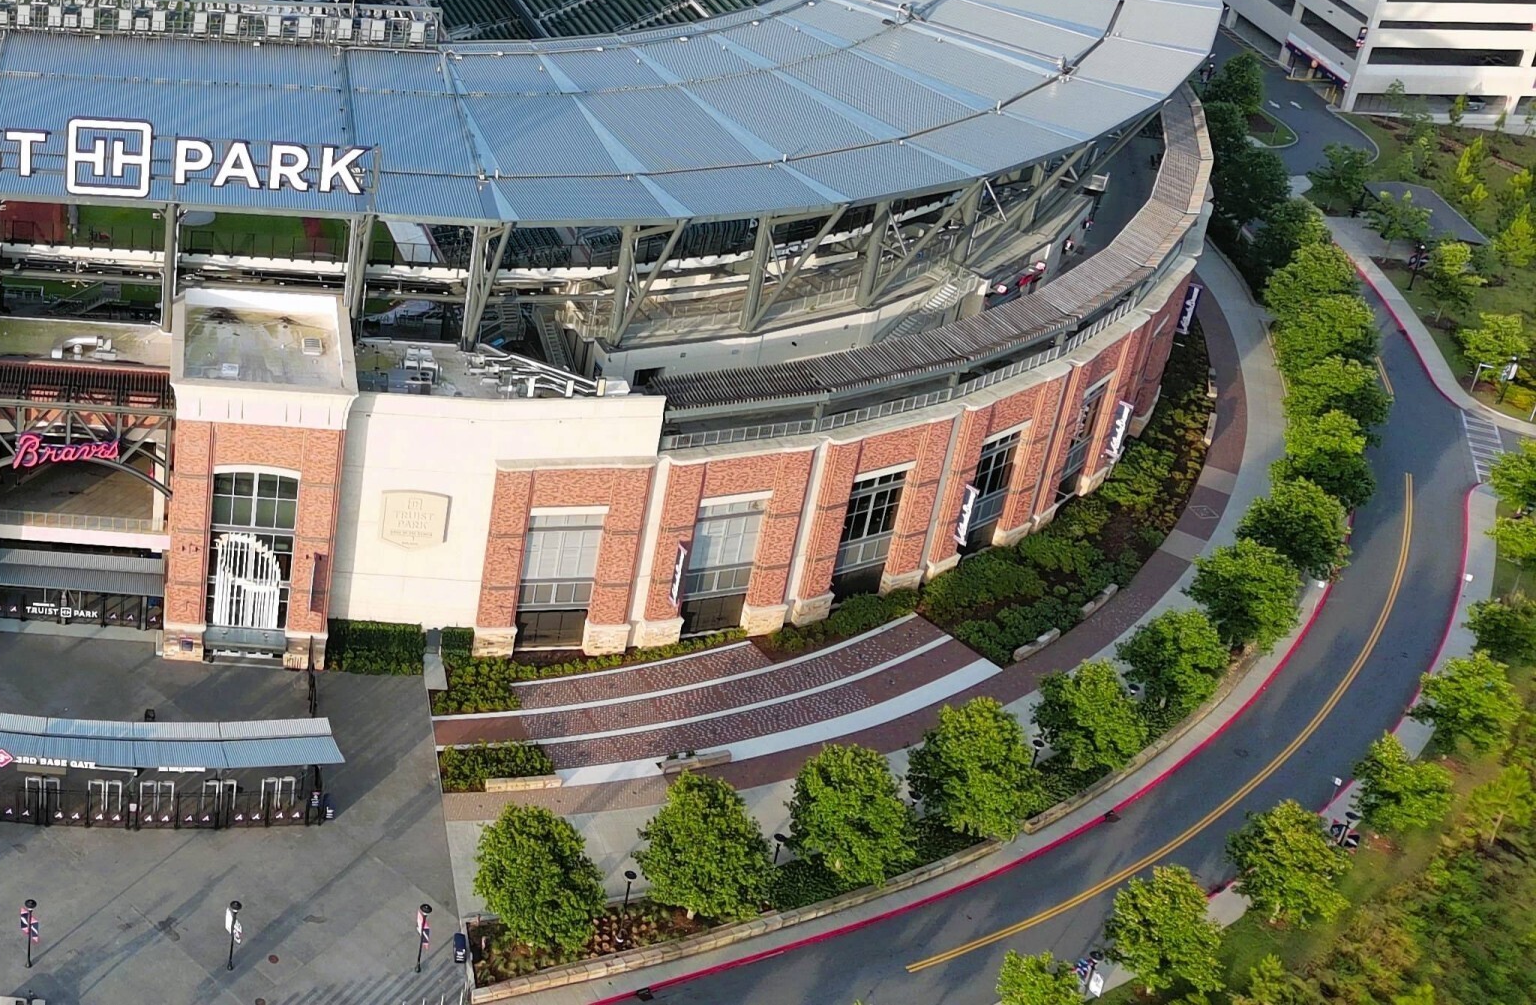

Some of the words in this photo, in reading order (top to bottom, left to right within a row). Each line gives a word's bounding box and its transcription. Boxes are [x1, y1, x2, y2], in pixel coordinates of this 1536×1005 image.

[174, 139, 362, 194] PARK
[13, 434, 120, 469] Braves
[396, 511, 434, 520] TRUIST
[398, 520, 428, 529] PARK
[26, 606, 58, 615] TRUIST
[74, 610, 98, 618] PARK
[16, 756, 37, 765] 3RD
[39, 758, 67, 767] BASE
[70, 760, 96, 769] GATE
